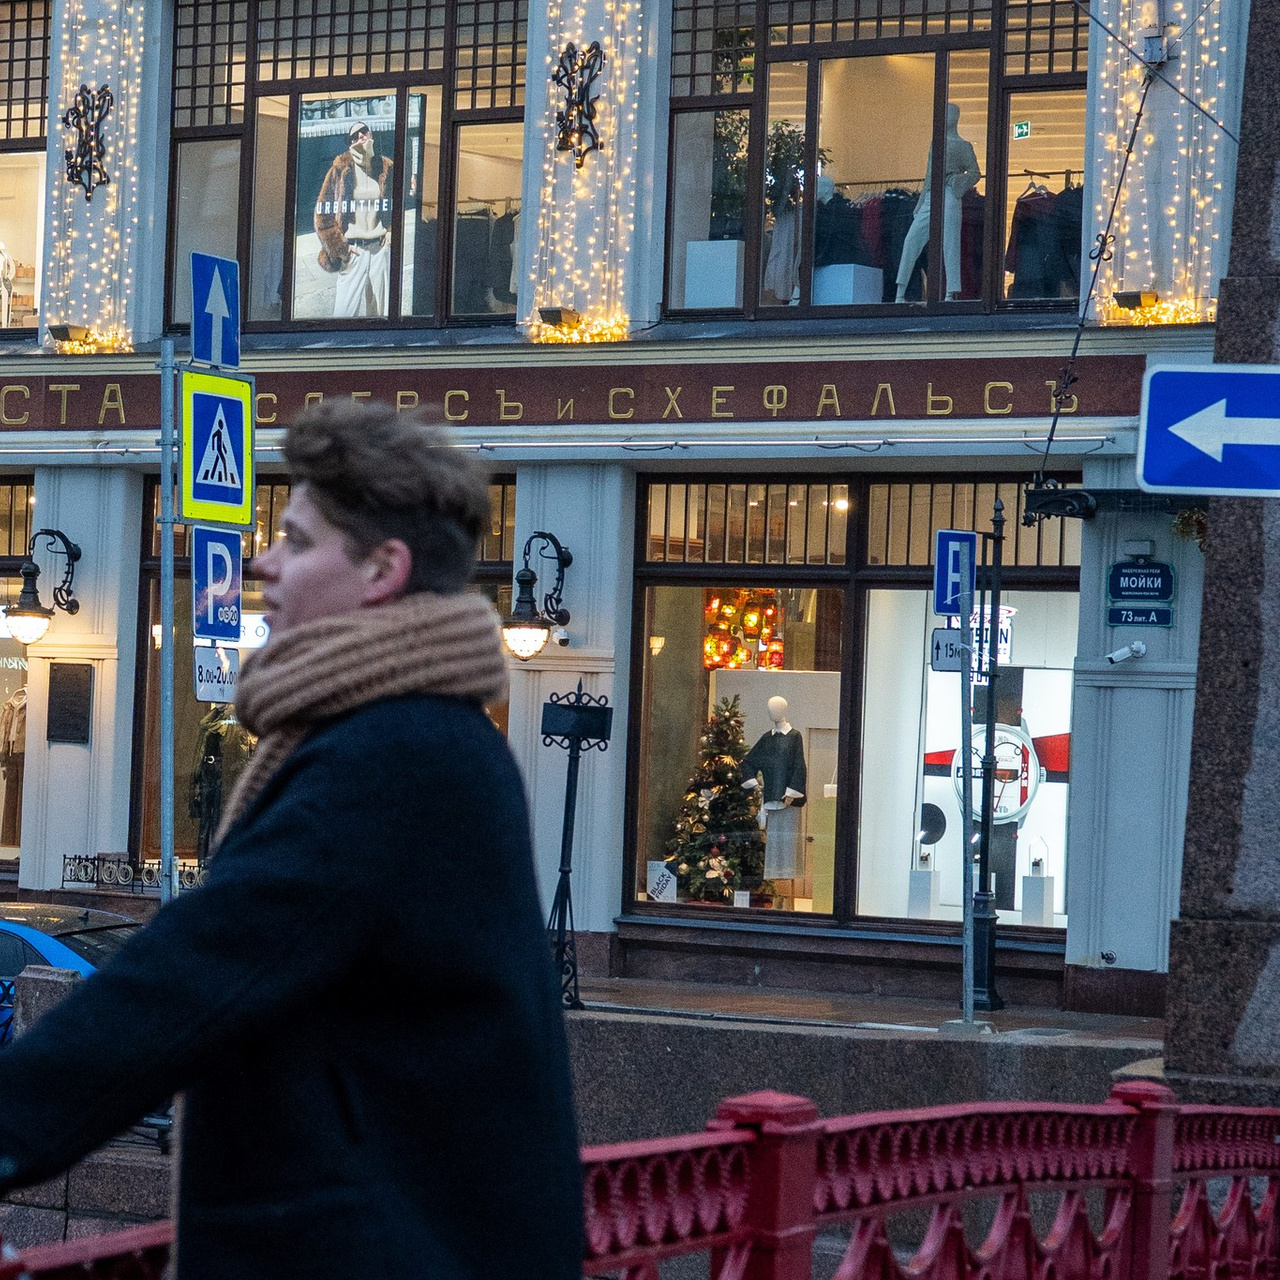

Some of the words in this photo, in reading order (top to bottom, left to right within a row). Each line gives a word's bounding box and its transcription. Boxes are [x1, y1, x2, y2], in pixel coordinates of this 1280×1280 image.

[317, 199, 393, 214] URBANTIGE
[1120, 575, 1162, 588] МОЙКИ
[1121, 611, 1133, 622] 73
[1149, 612, 1157, 622] А
[650, 872, 667, 895] BLACK
[655, 874, 672, 899] FRIDAY
